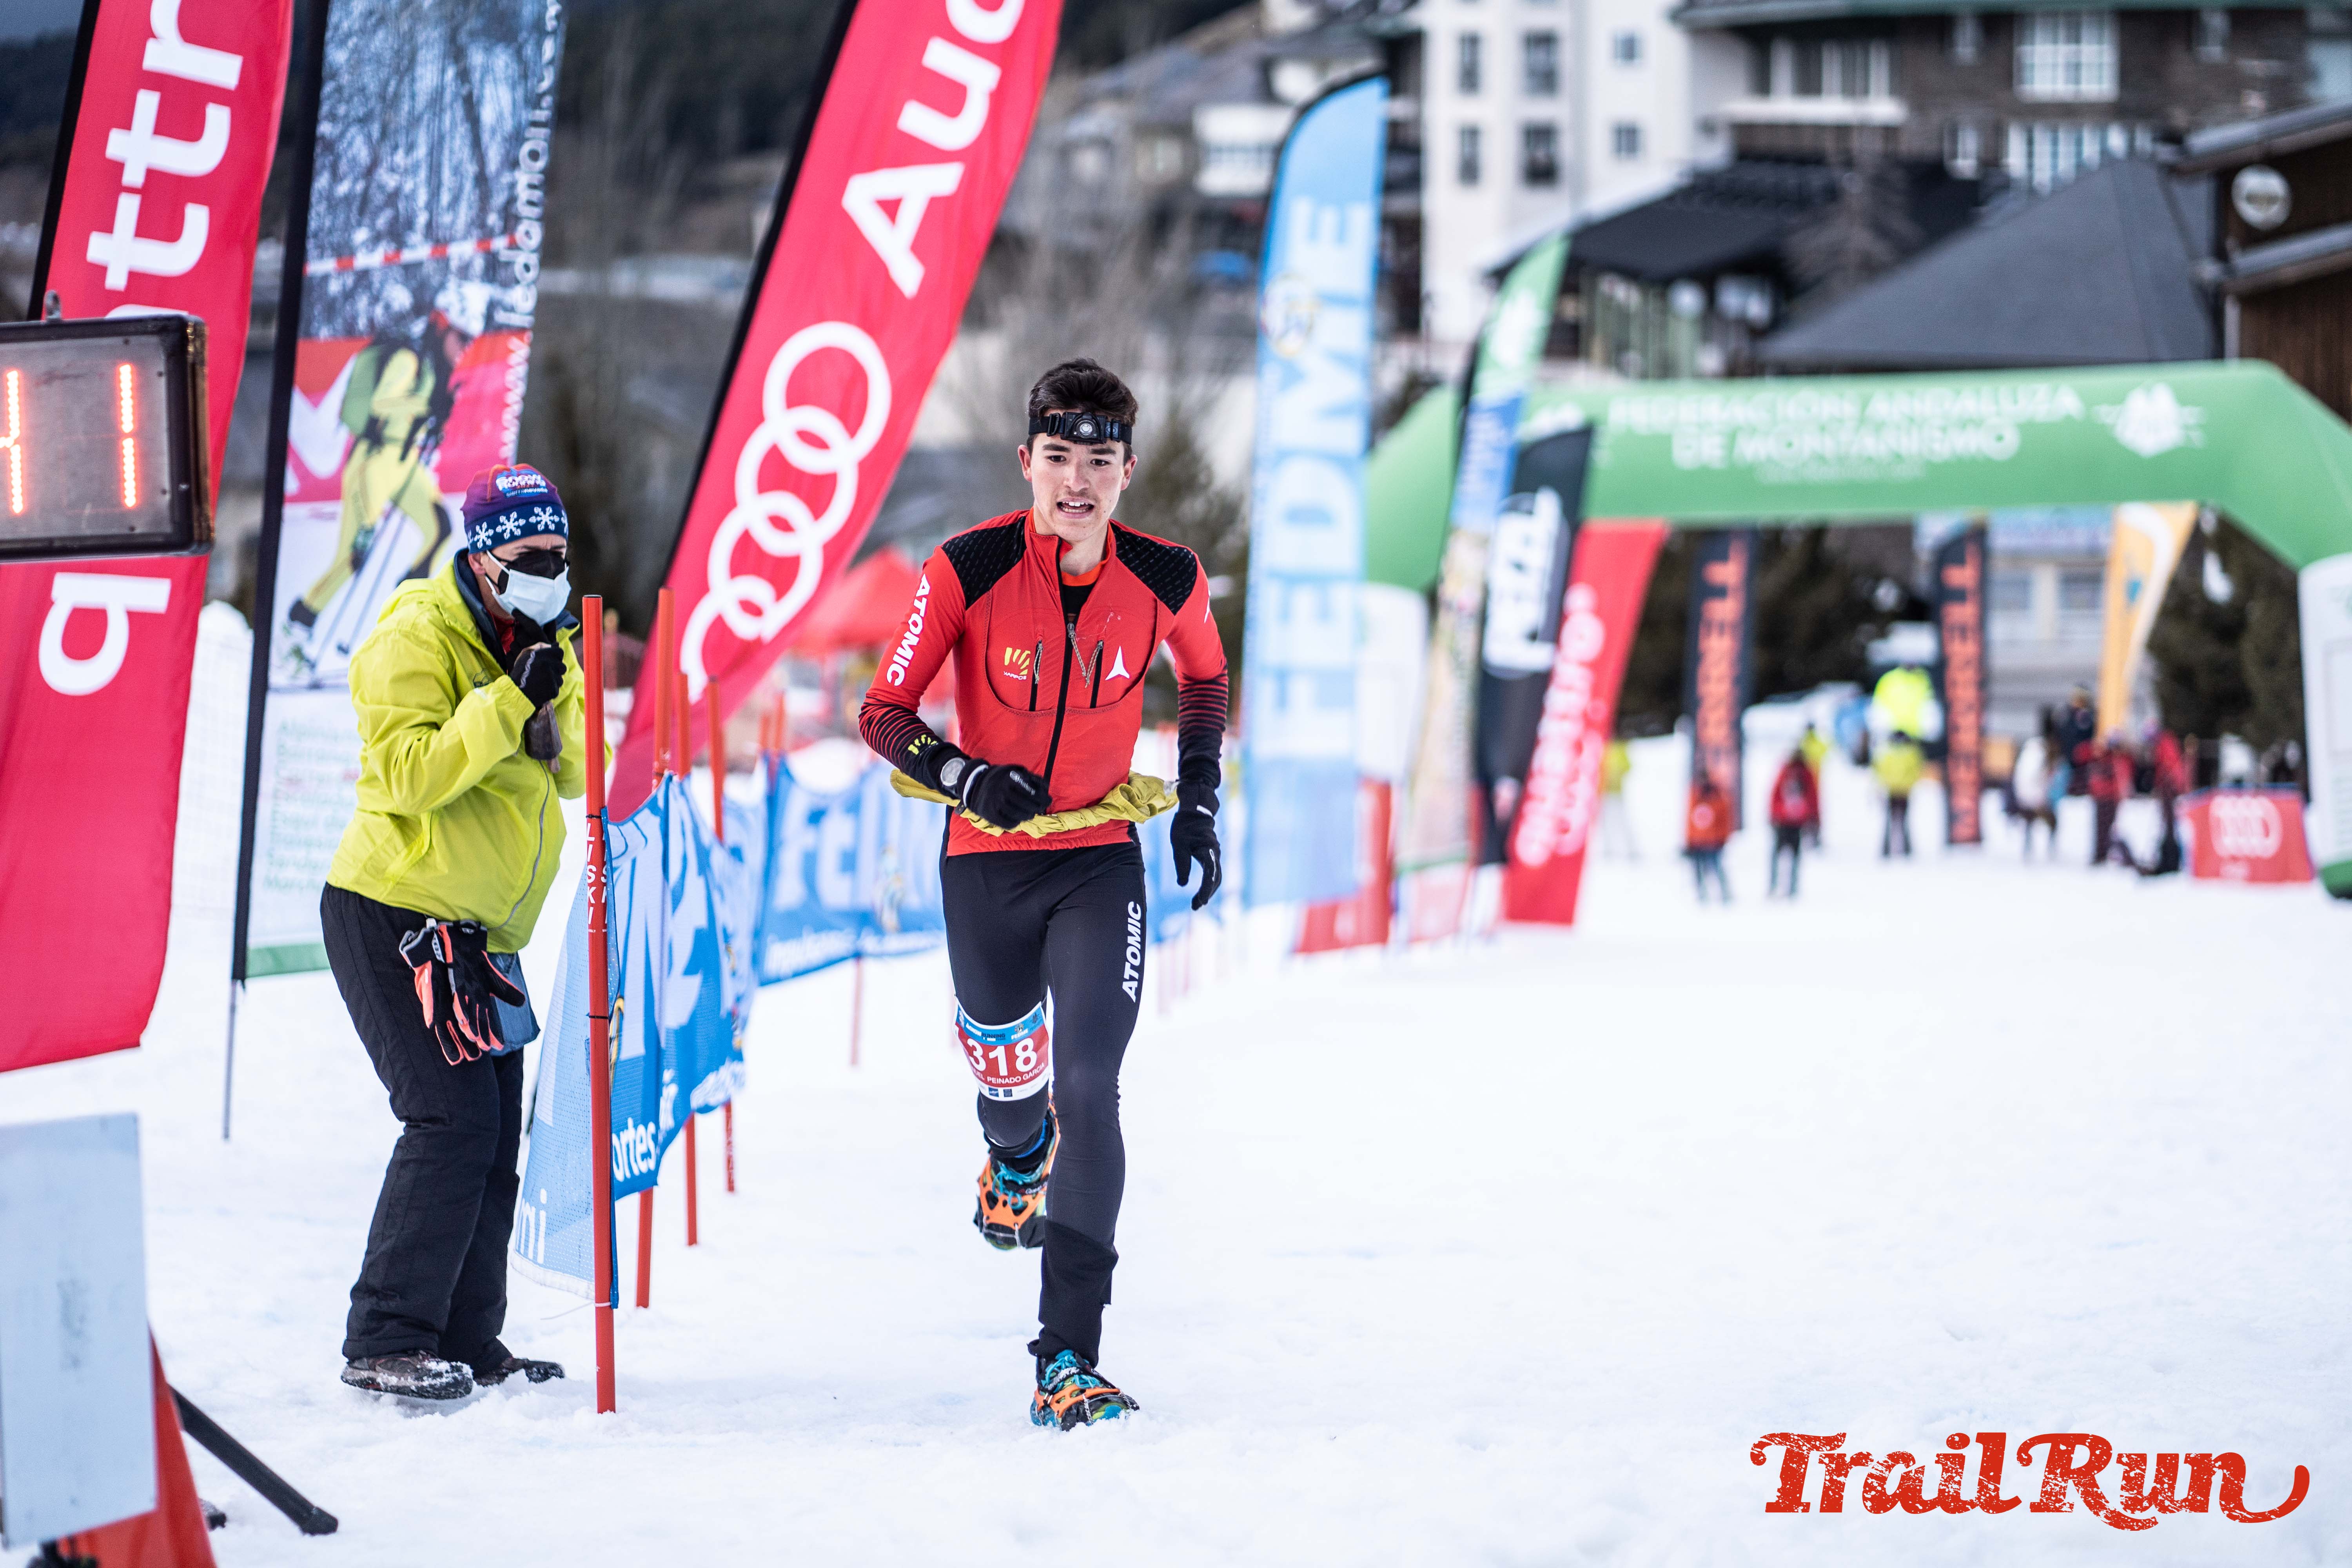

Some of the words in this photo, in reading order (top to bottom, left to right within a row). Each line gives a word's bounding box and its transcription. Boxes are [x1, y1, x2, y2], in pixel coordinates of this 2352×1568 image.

[886, 573, 932, 687] ATOMIC
[586, 822, 597, 925] LISKI
[1122, 900, 1142, 1003] ATOMIC
[966, 1037, 1038, 1076] 318
[987, 1076, 1022, 1084] PEINADO
